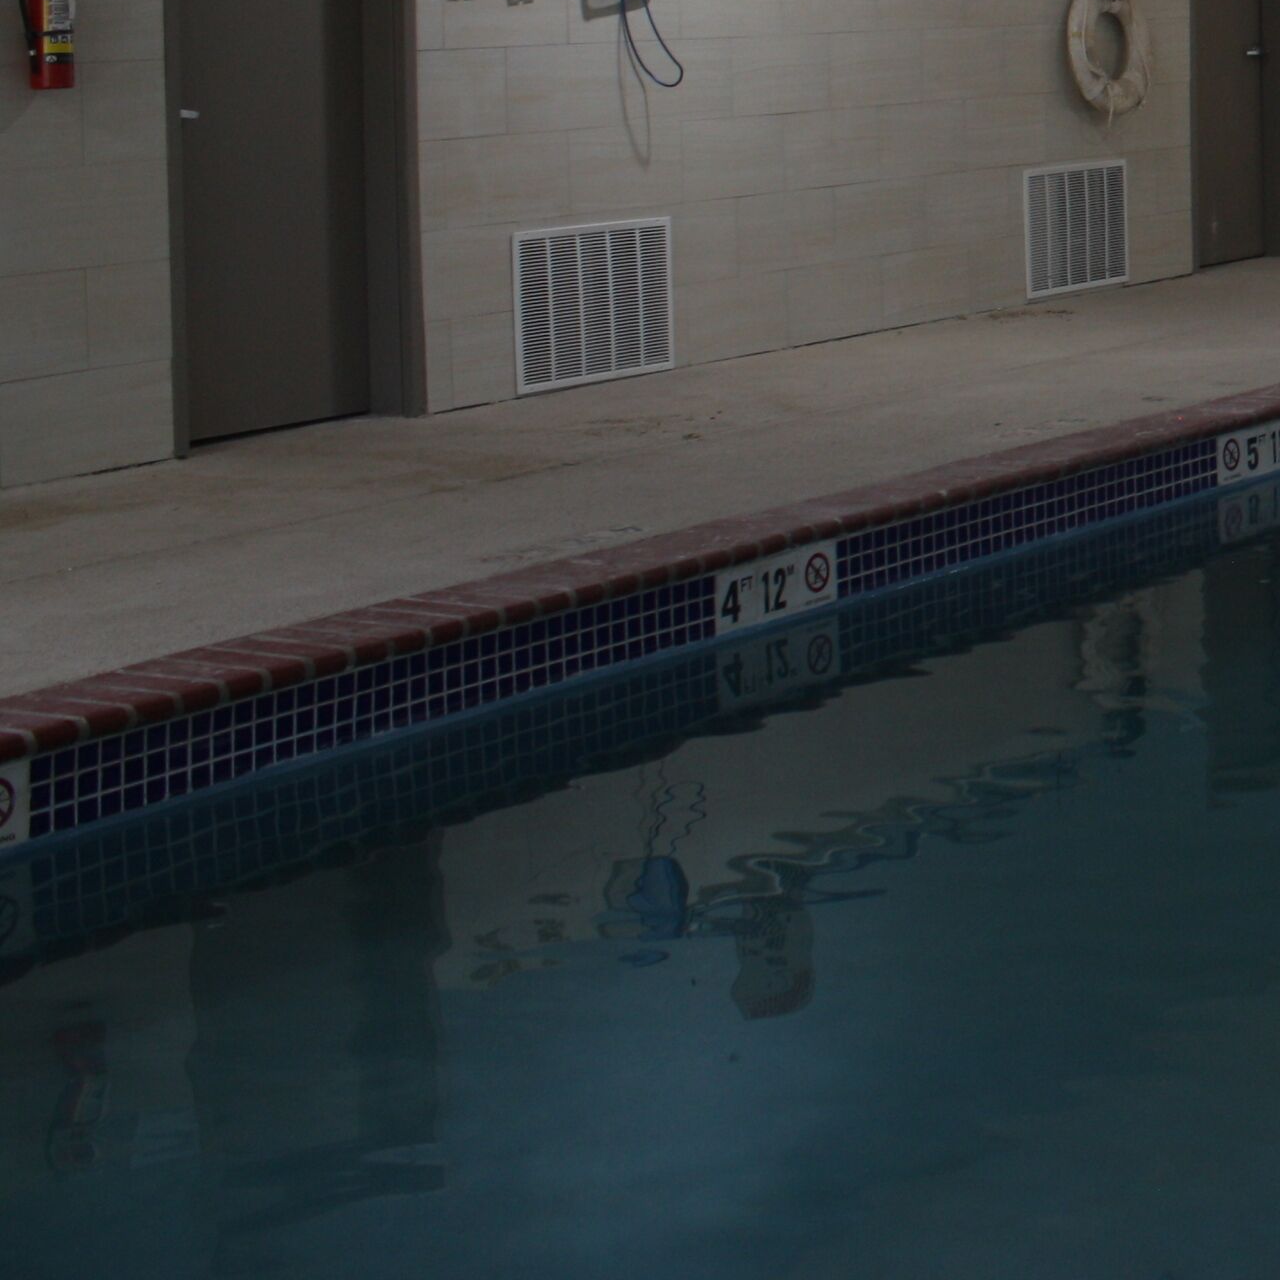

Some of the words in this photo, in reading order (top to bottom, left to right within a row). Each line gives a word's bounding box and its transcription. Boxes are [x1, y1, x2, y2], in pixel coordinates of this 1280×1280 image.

[1247, 436, 1259, 471] 5
[721, 579, 741, 623] 4
[740, 575, 753, 593] FT
